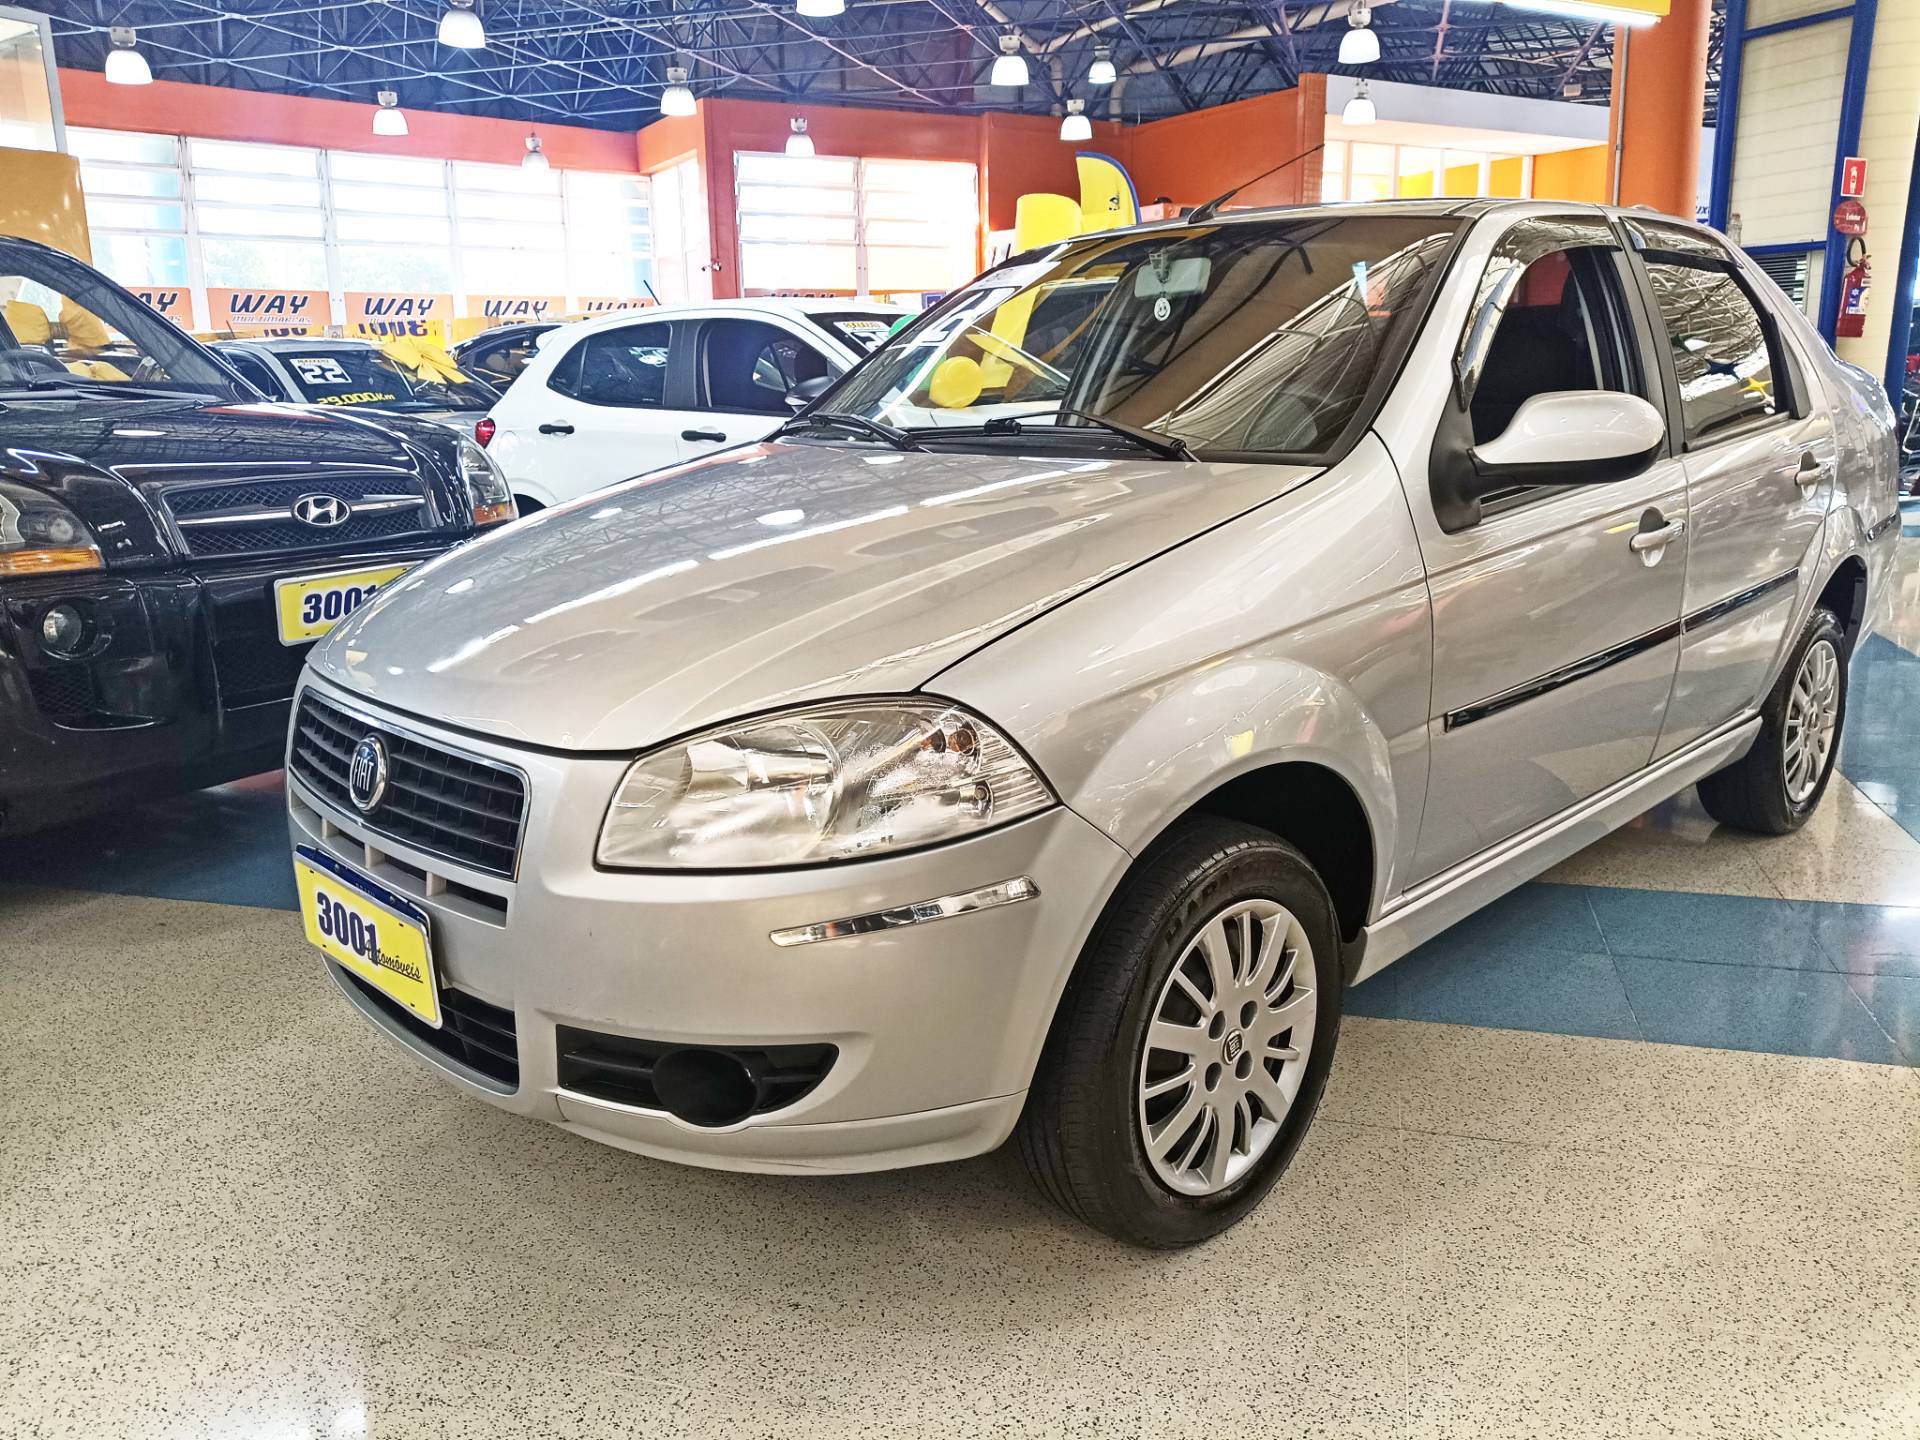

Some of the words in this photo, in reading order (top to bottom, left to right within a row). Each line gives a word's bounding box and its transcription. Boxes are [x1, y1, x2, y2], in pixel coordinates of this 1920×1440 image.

[138, 292, 178, 312] AY
[230, 294, 309, 314] WAY
[364, 297, 435, 316] WAY
[483, 299, 548, 317] WAY
[300, 365, 347, 384] 22
[352, 755, 375, 792] FIAT
[316, 891, 379, 967] 3001
[363, 939, 422, 980] Atomóveis
